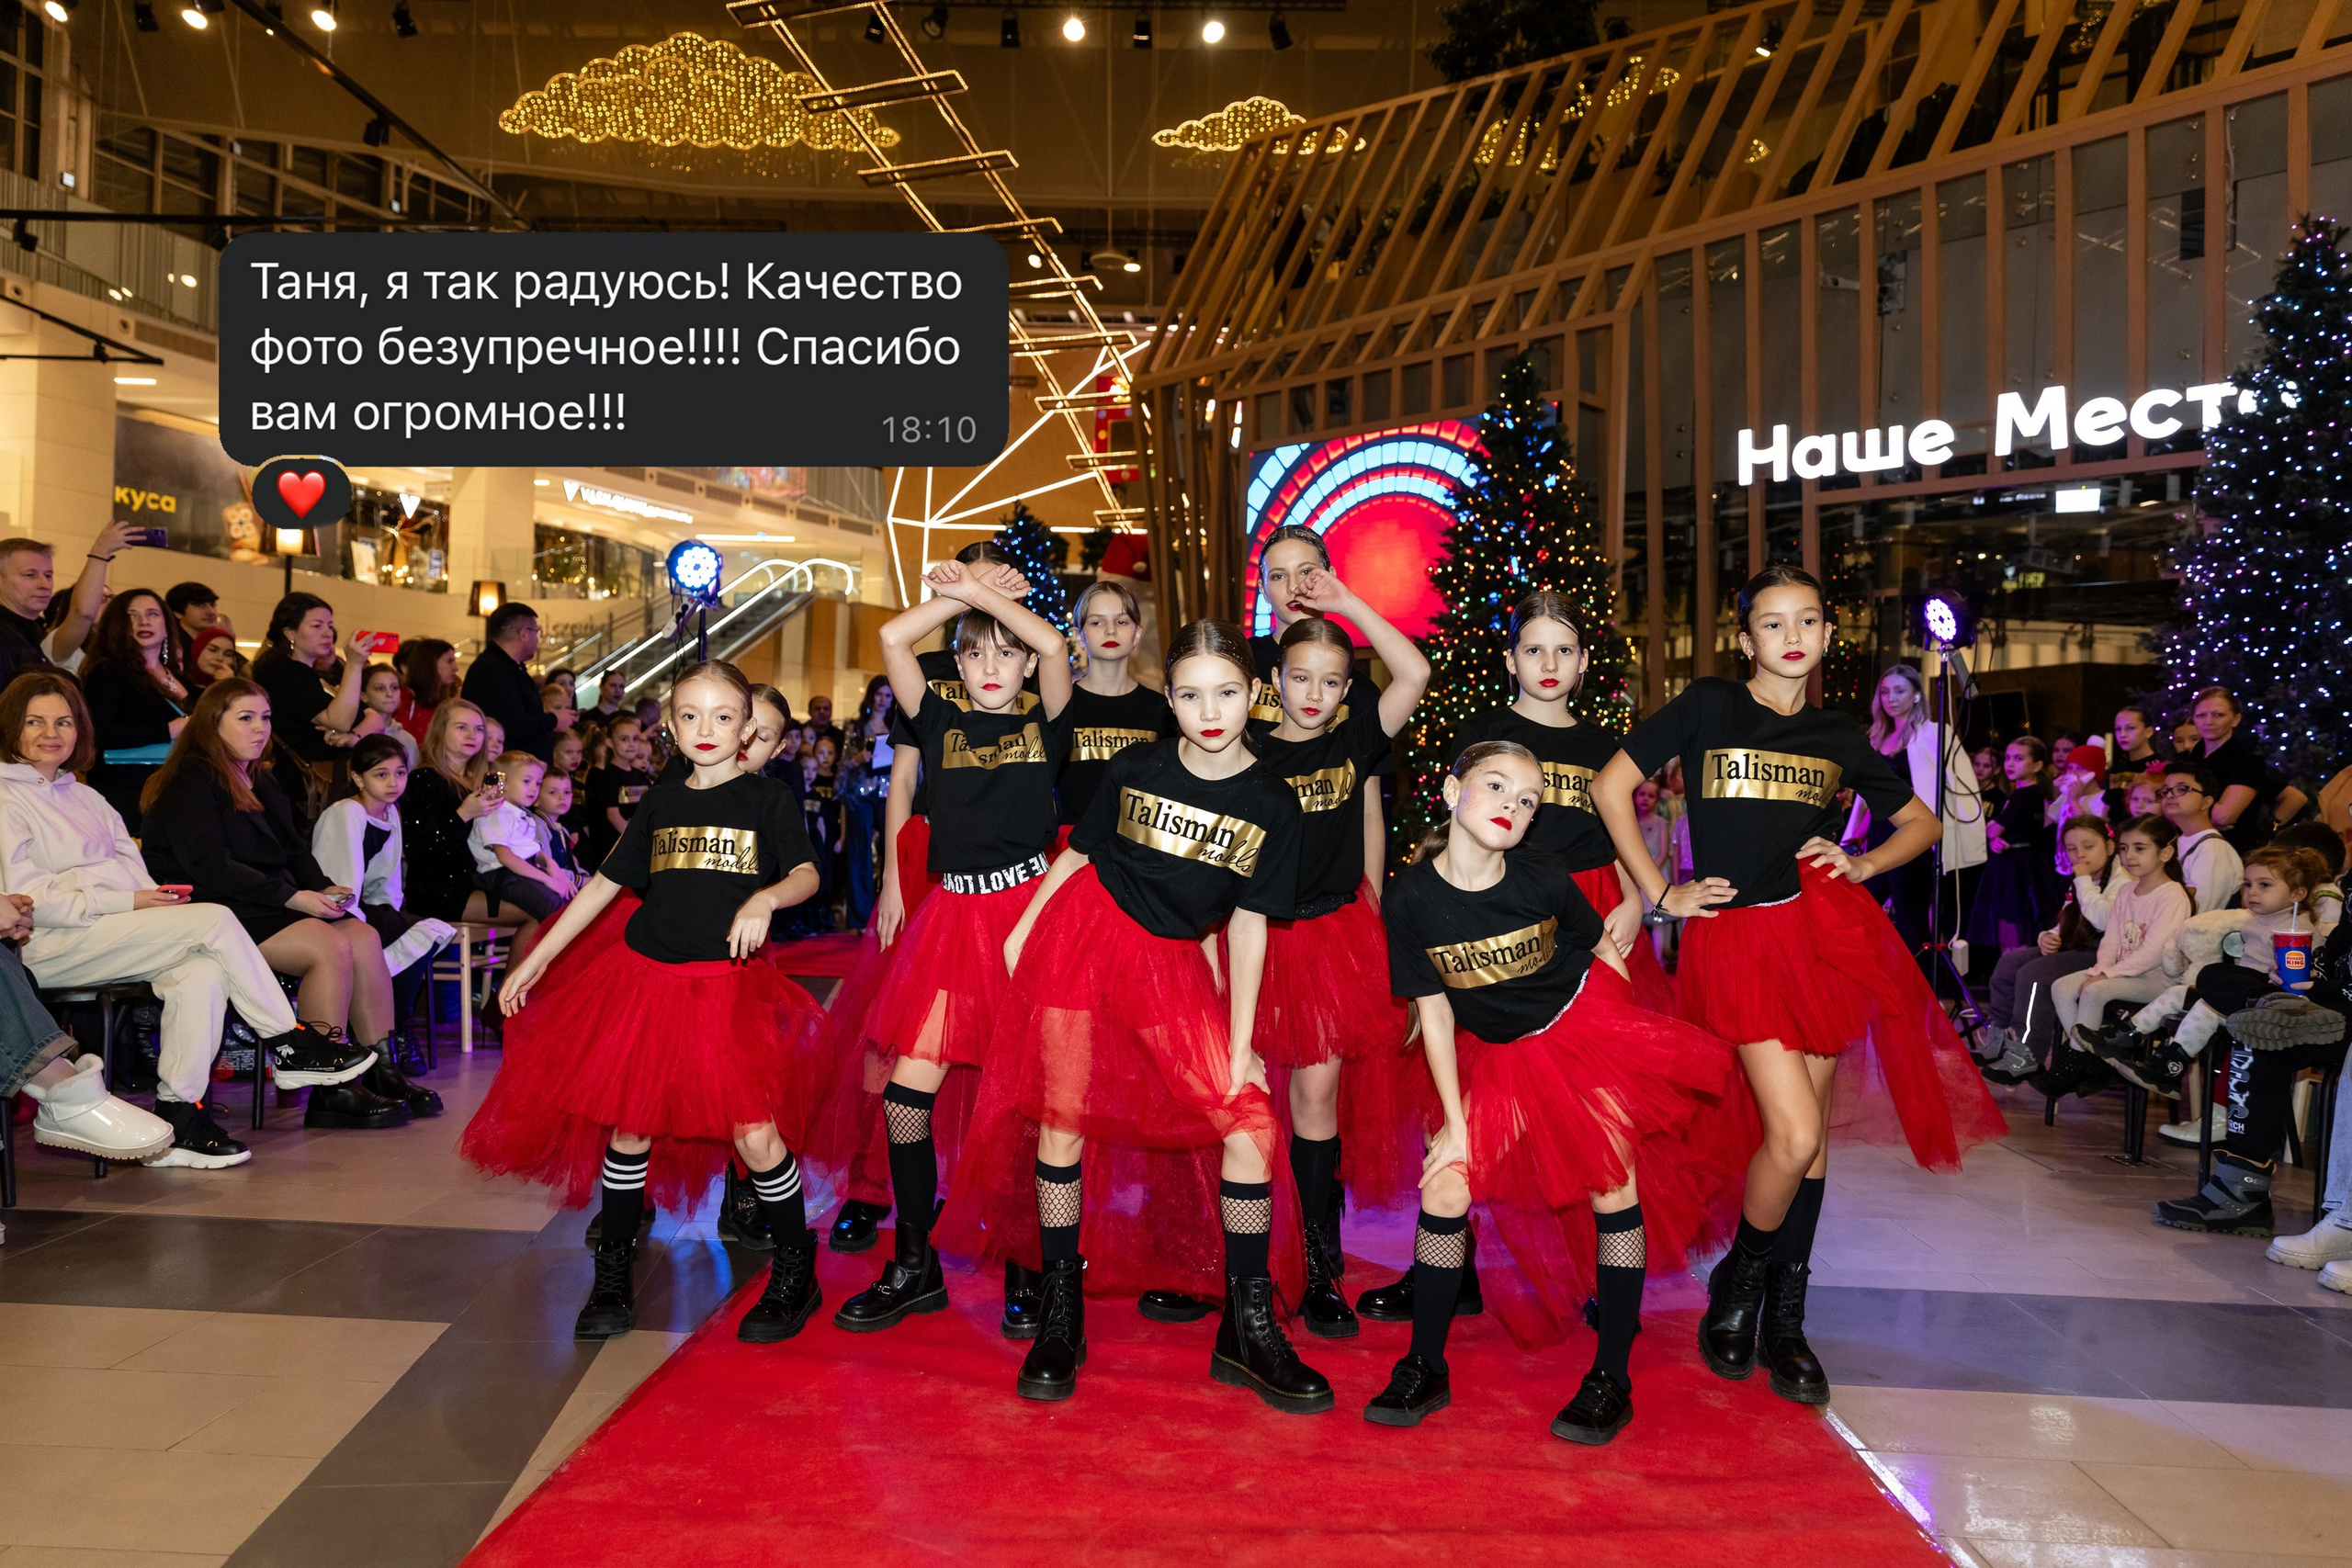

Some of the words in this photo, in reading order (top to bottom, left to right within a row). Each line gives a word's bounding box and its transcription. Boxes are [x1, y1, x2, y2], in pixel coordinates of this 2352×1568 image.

[1737, 419, 1955, 486] Наше
[1712, 753, 1825, 789] Talisman
[1126, 793, 1235, 850] Talisman
[653, 830, 736, 857] Talisman
[978, 863, 1030, 895] LOVE
[1432, 935, 1542, 975] Talisman
